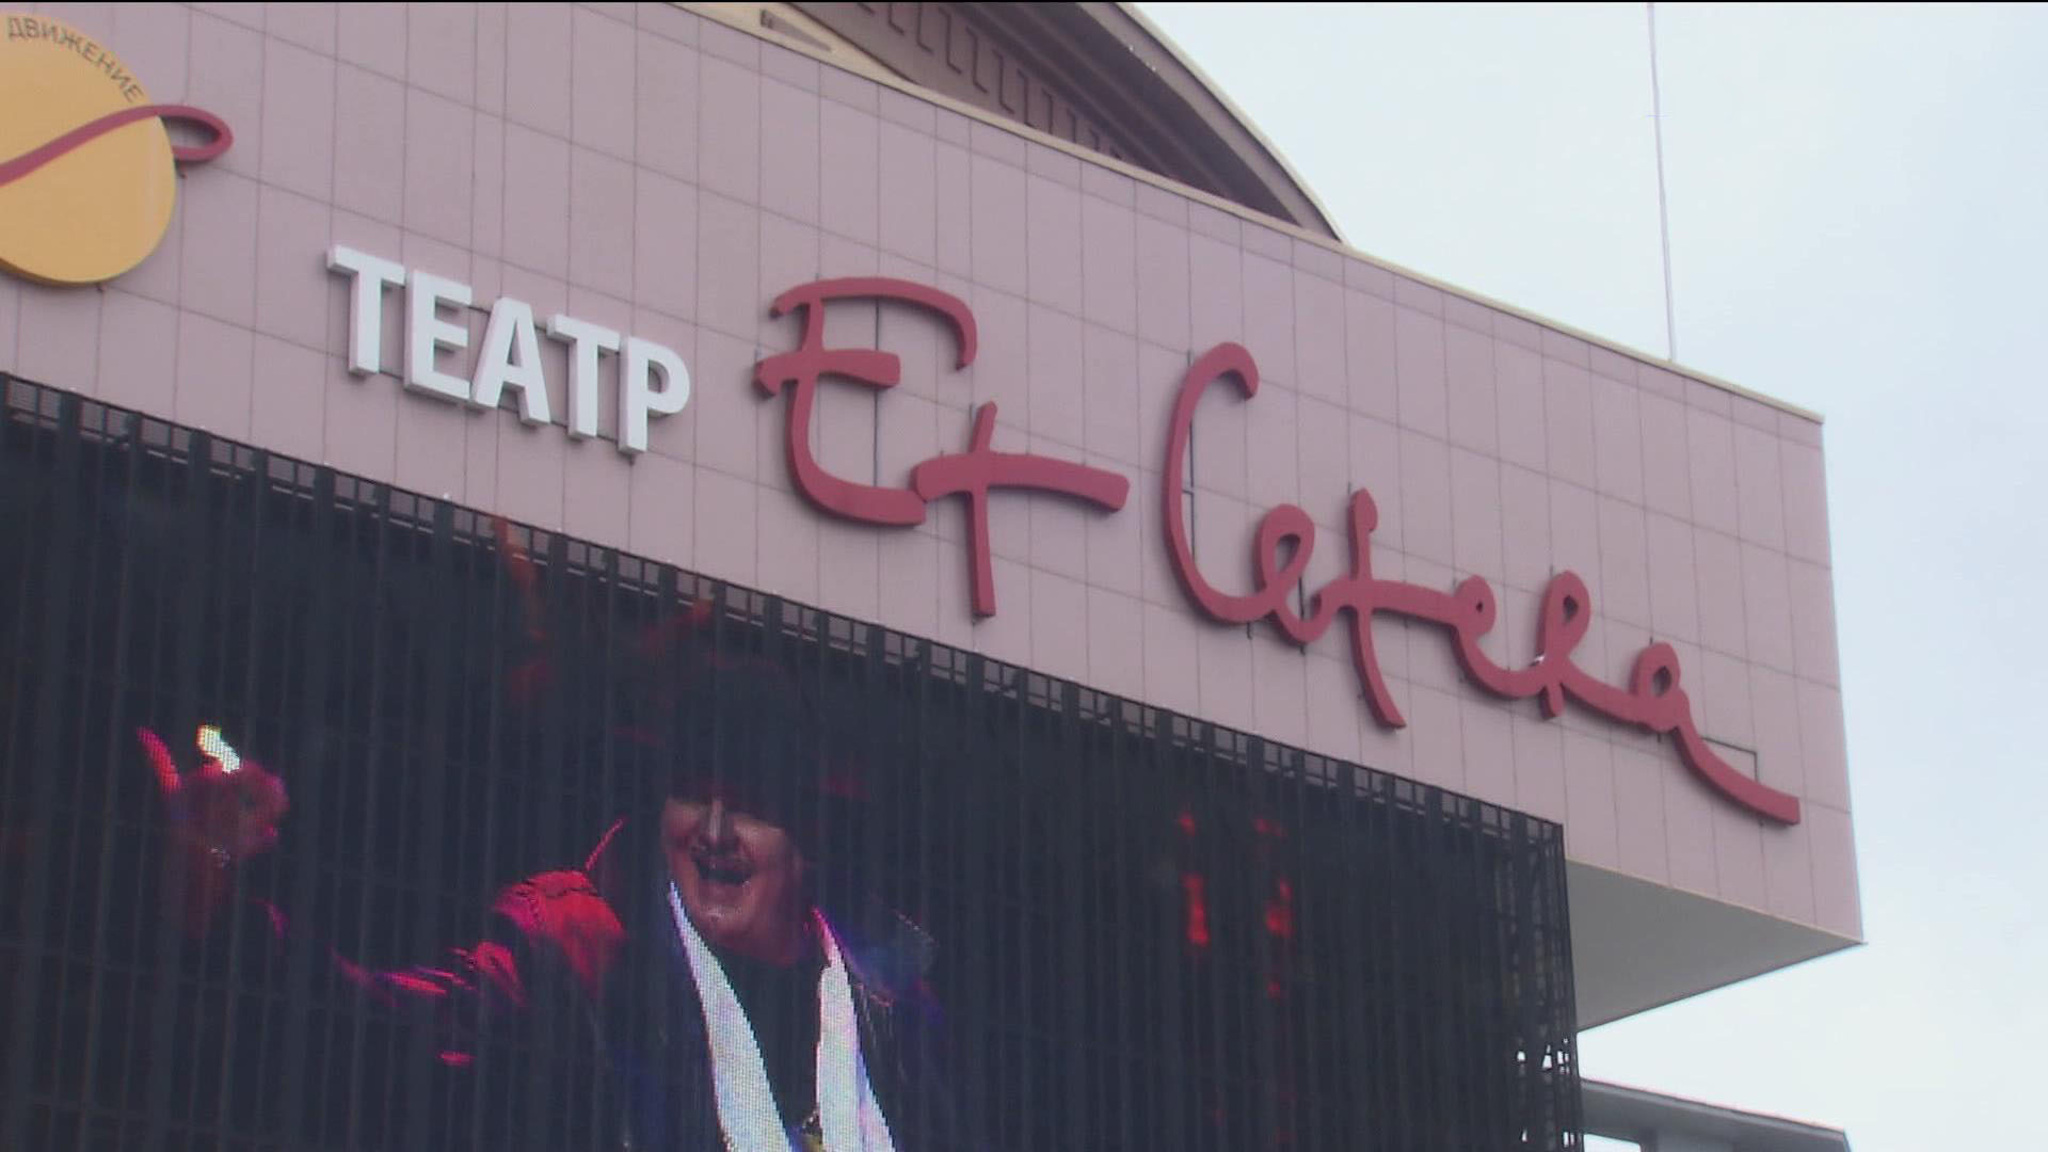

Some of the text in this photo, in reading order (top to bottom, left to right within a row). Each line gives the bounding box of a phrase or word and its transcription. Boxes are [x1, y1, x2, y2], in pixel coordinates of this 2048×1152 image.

[7, 16, 145, 104] ДВИЖЕНИЕ
[327, 245, 690, 455] ТЕАТР
[753, 277, 1800, 826] Et Cetera
